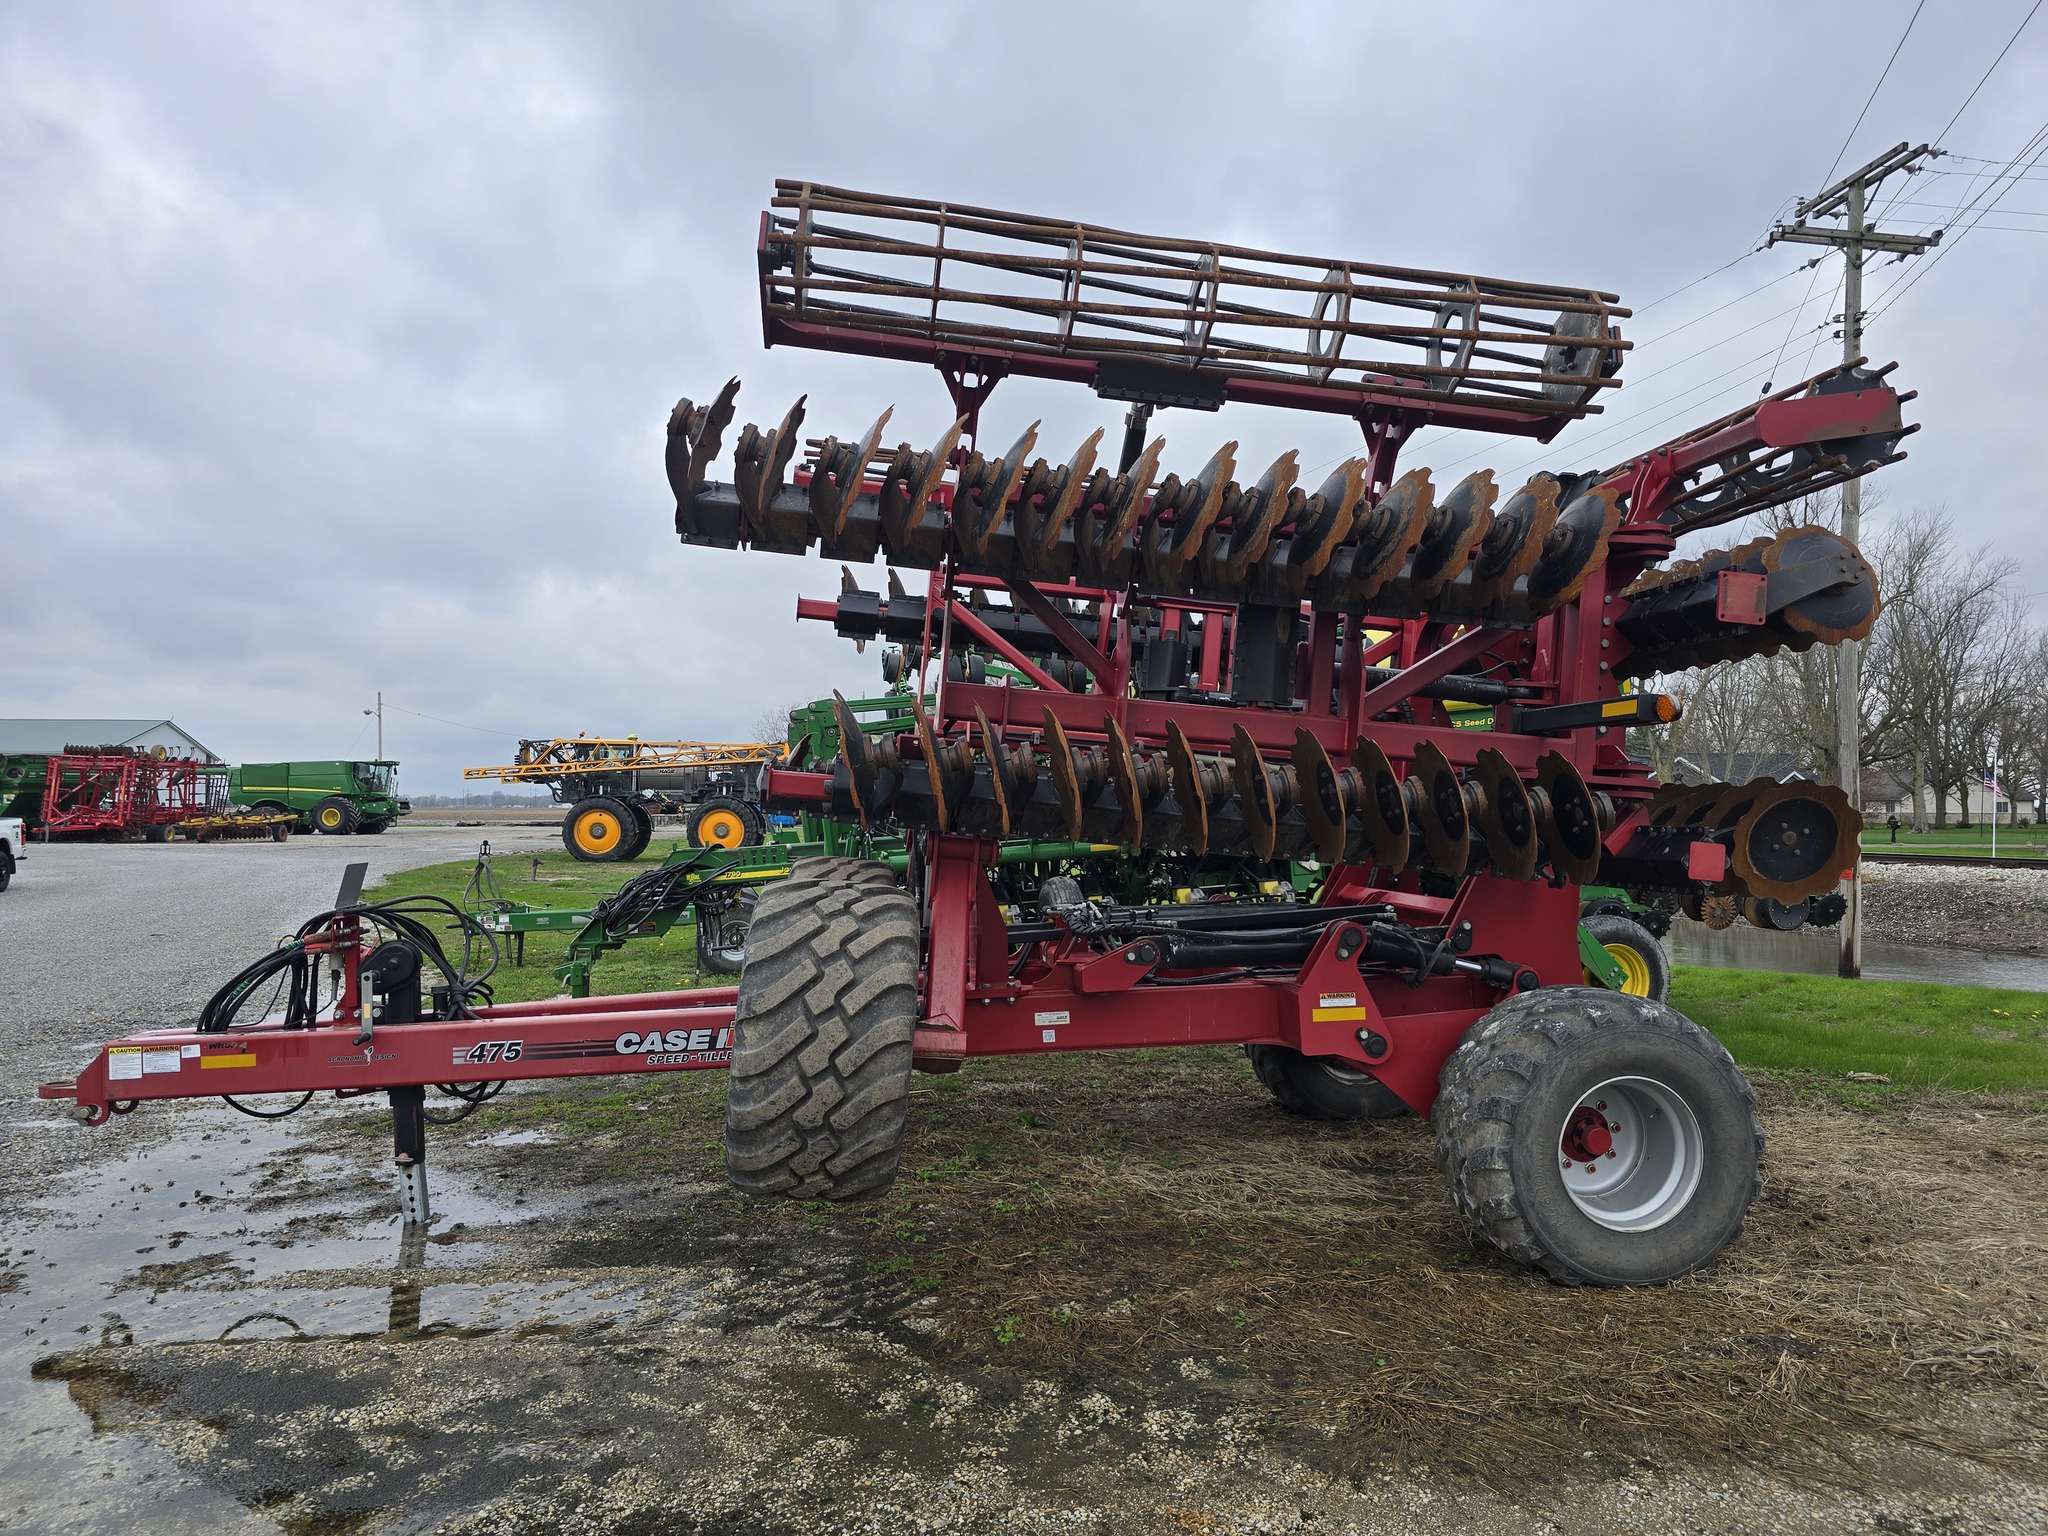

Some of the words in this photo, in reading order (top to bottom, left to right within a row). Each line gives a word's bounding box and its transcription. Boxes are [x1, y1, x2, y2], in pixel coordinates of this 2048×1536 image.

[1464, 719, 1485, 727] Seed
[615, 1028, 712, 1054] CASE
[467, 1040, 523, 1063] 475
[647, 1051, 733, 1065] SPEED-TILLE
